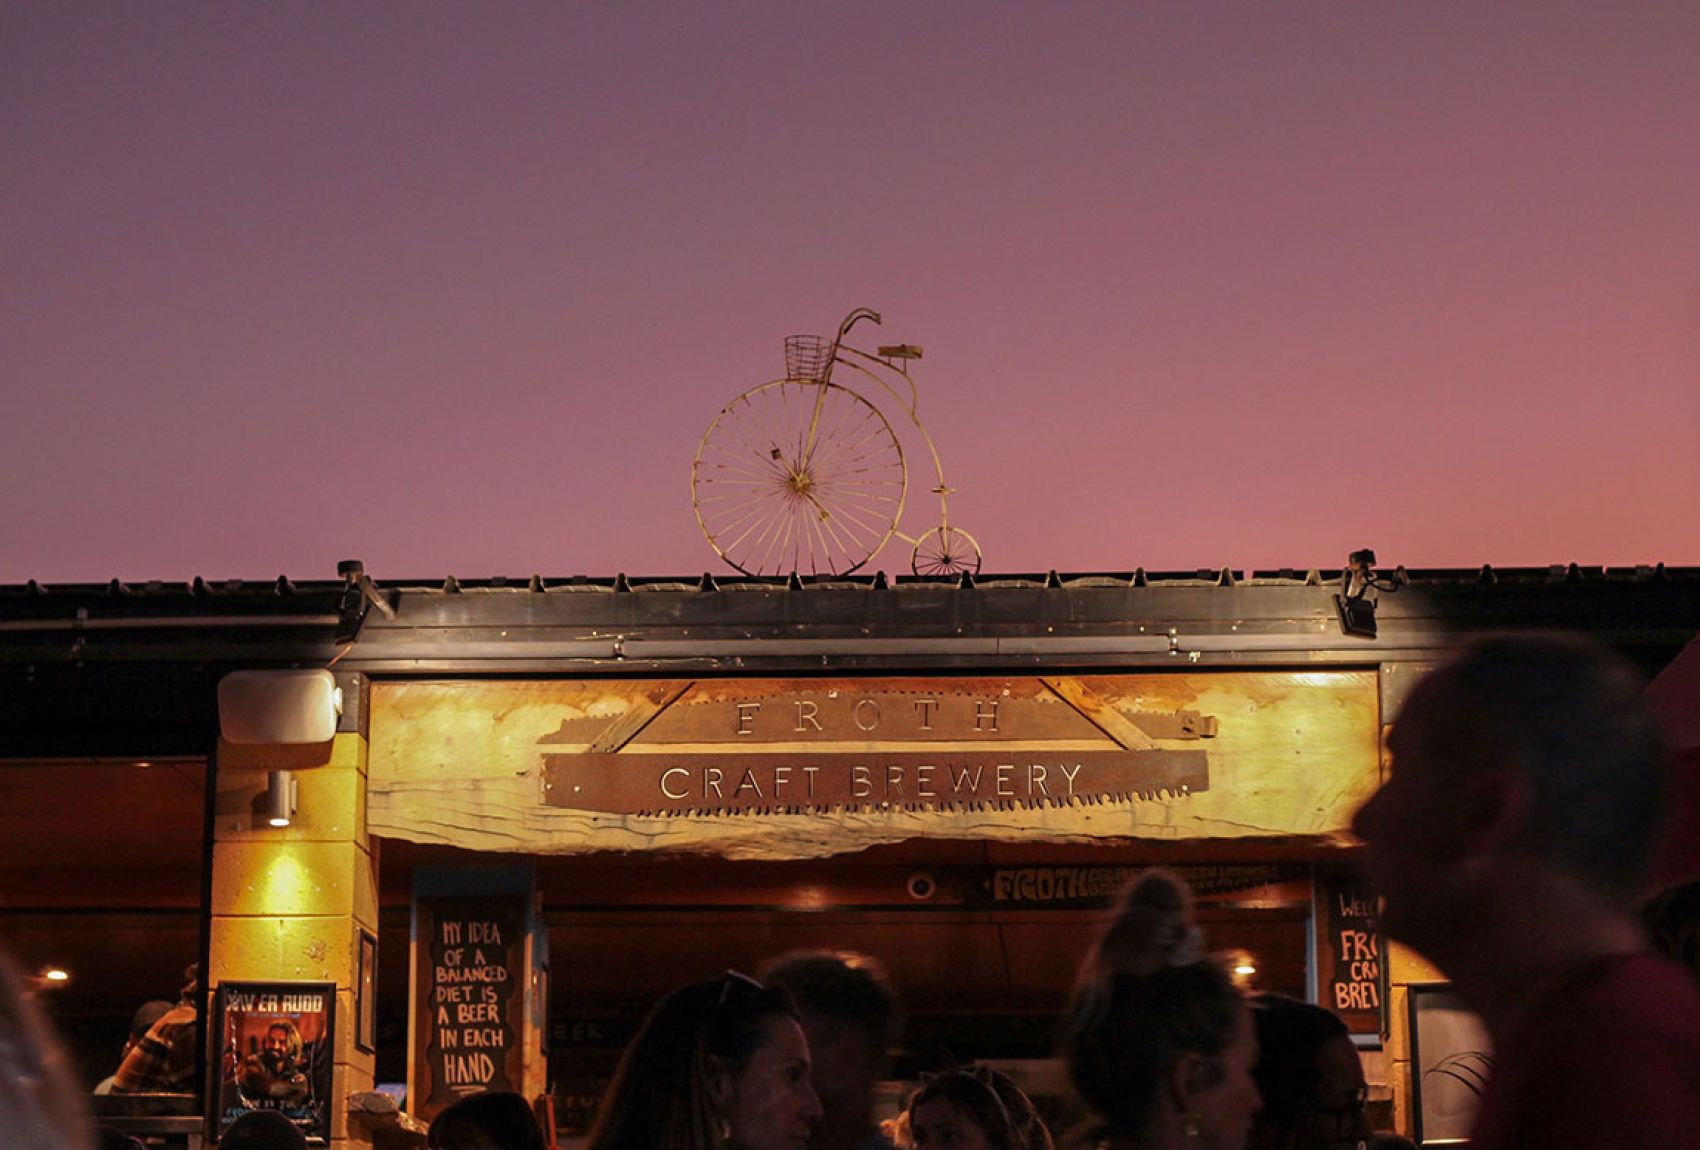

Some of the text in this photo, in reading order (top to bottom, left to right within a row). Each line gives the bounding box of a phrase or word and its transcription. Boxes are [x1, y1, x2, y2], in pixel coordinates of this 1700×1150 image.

[737, 699, 998, 735] FROTH
[660, 764, 1082, 799] CRAFT BREWERY
[443, 921, 501, 945] MY IDEA
[444, 948, 486, 966] OF A
[435, 966, 508, 983] BALANCED
[436, 986, 498, 1002] DIET IS
[437, 1004, 500, 1024] A BEER
[440, 1029, 504, 1049] IN EACH
[444, 1052, 495, 1085] HAND
